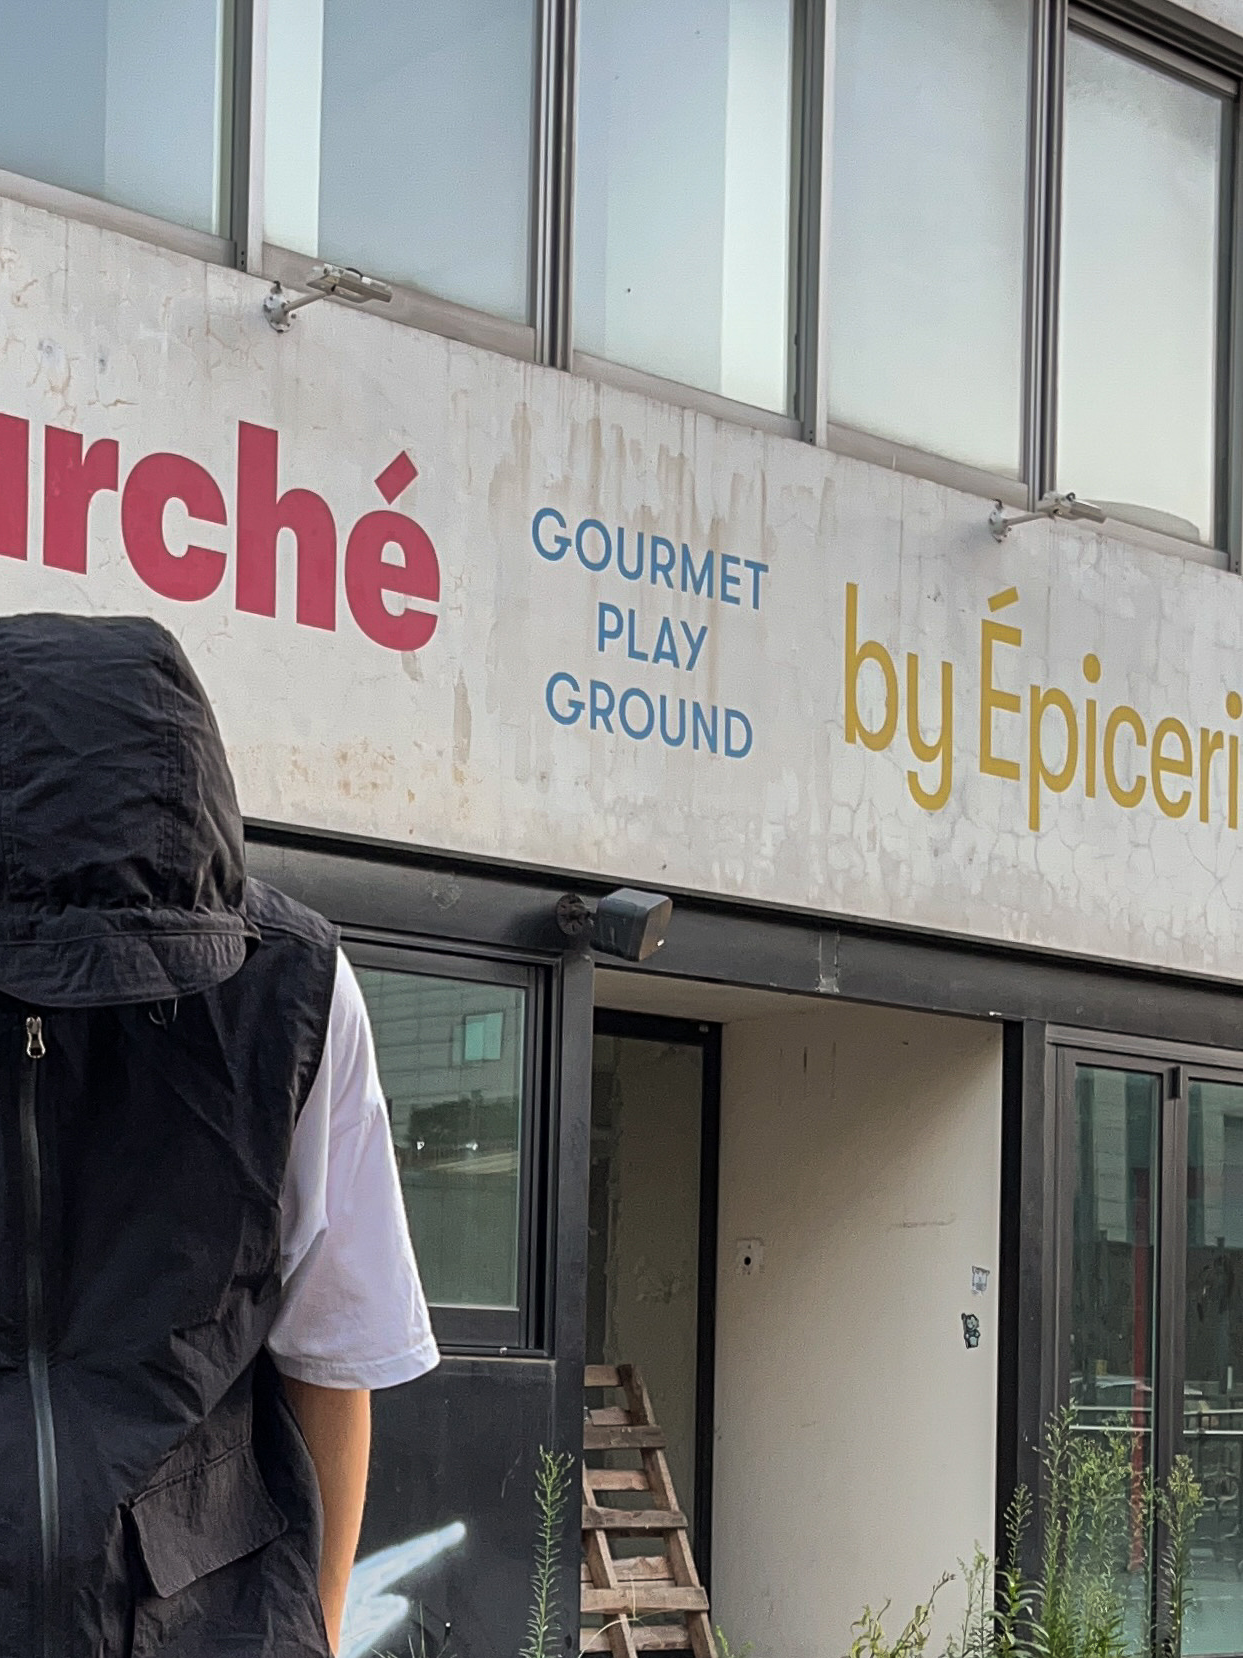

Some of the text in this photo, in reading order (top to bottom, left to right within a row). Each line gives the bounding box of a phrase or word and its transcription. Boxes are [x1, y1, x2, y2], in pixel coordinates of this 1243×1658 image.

[531, 507, 769, 611] GOURMET
[597, 602, 708, 672] PLAY
[546, 672, 754, 760] GROUND
[844, 582, 1243, 833] by Épiceri
